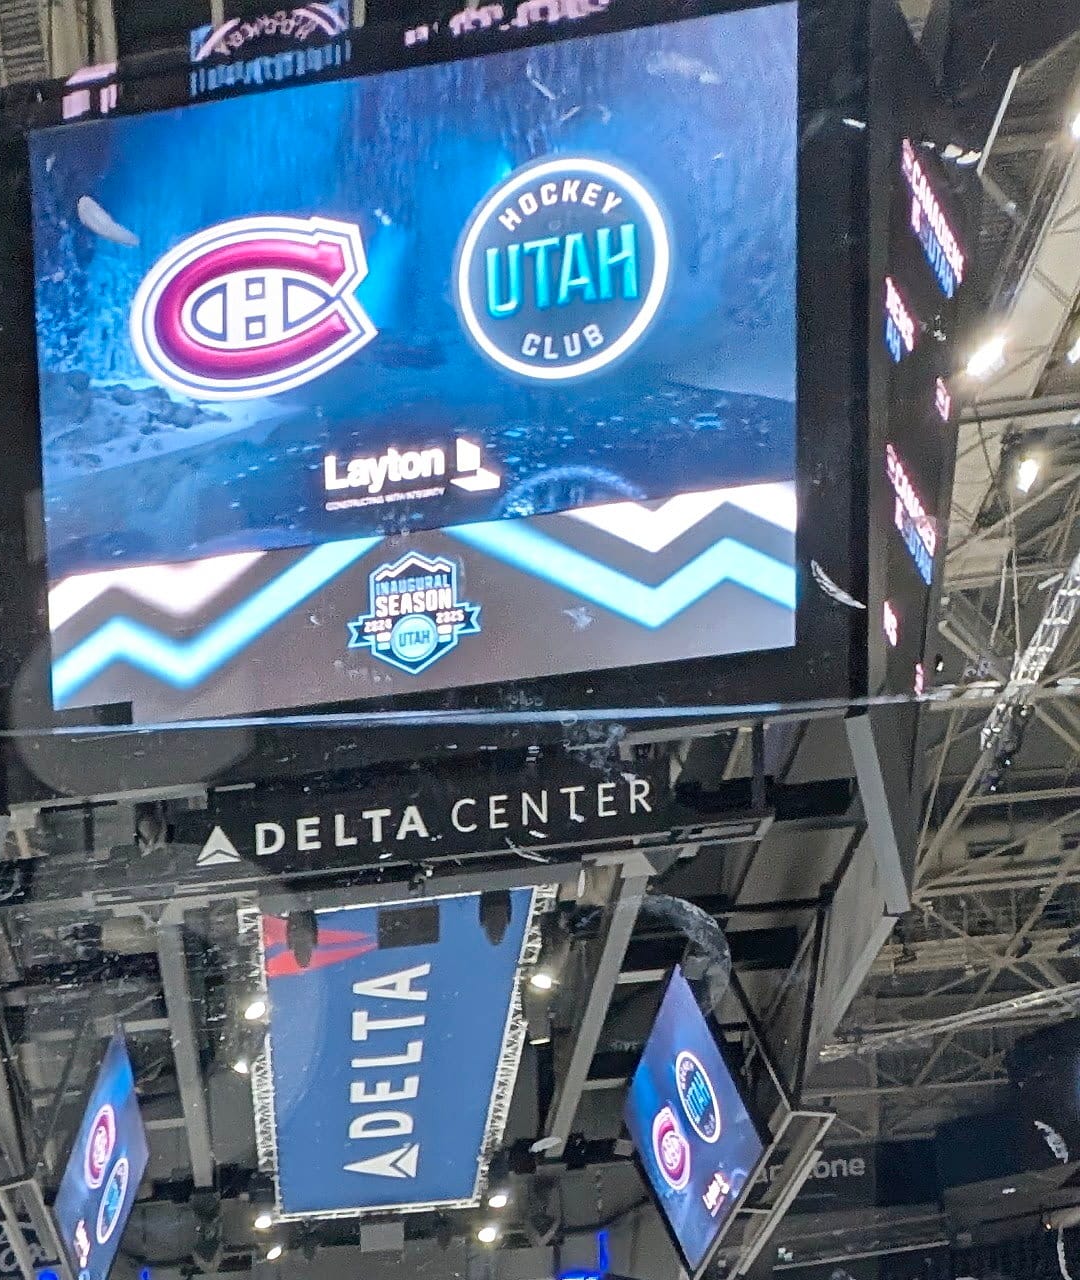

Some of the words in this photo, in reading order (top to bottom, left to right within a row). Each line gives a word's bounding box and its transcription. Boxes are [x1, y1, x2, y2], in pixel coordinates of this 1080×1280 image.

[498, 180, 622, 232] HOCKEY
[486, 223, 638, 318] UTAH
[522, 324, 604, 360] CLUB
[324, 448, 445, 493] Layton
[376, 574, 450, 595] INAUGURAL
[376, 588, 452, 618] SEASON
[364, 619, 393, 633] 2024
[398, 630, 430, 648] UTAH
[256, 807, 429, 857] DELTA
[451, 778, 653, 834] CENTER
[350, 963, 431, 1140] DELTA
